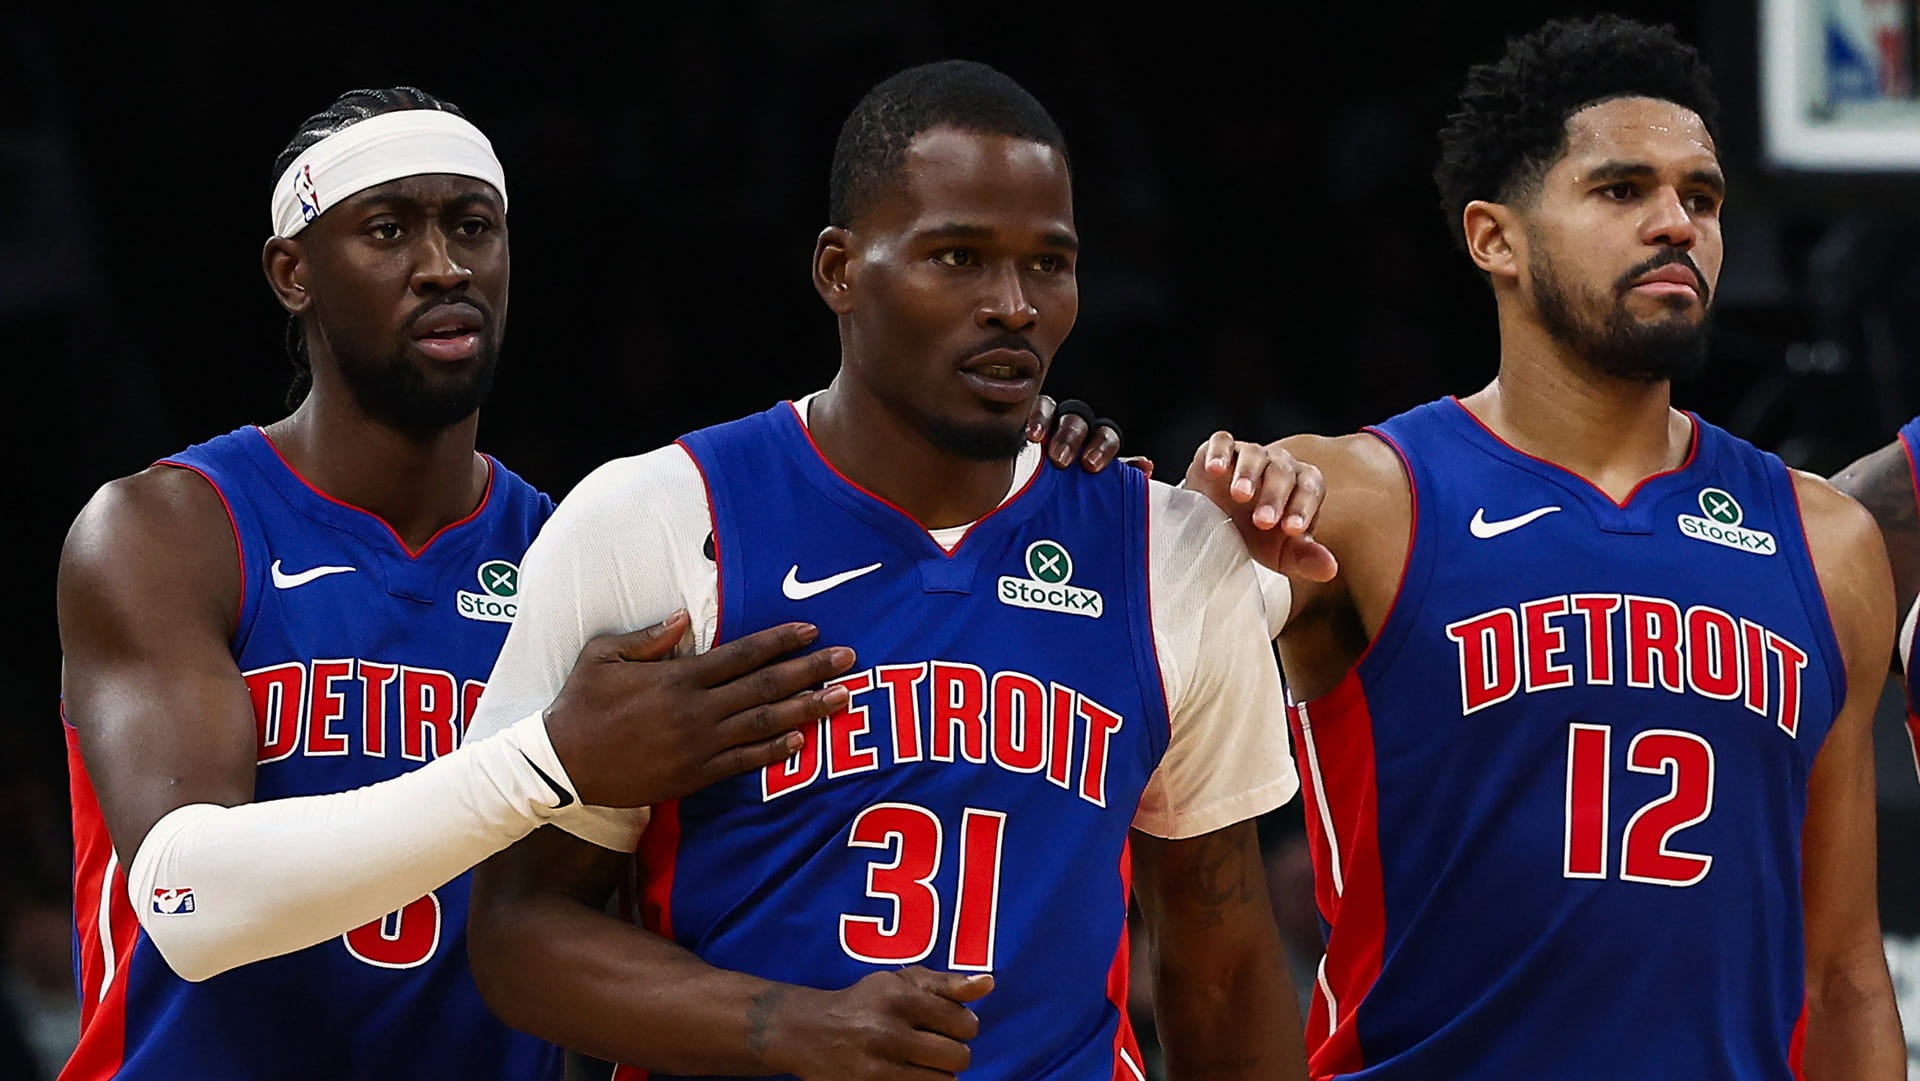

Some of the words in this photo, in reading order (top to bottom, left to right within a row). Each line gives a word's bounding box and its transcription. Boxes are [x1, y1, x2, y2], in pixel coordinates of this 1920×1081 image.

[1002, 580, 1098, 613] StockX
[1682, 517, 1772, 551] StockX
[1446, 594, 1808, 739] DETROIT
[1563, 723, 1715, 887] 12
[840, 802, 1007, 972] 31
